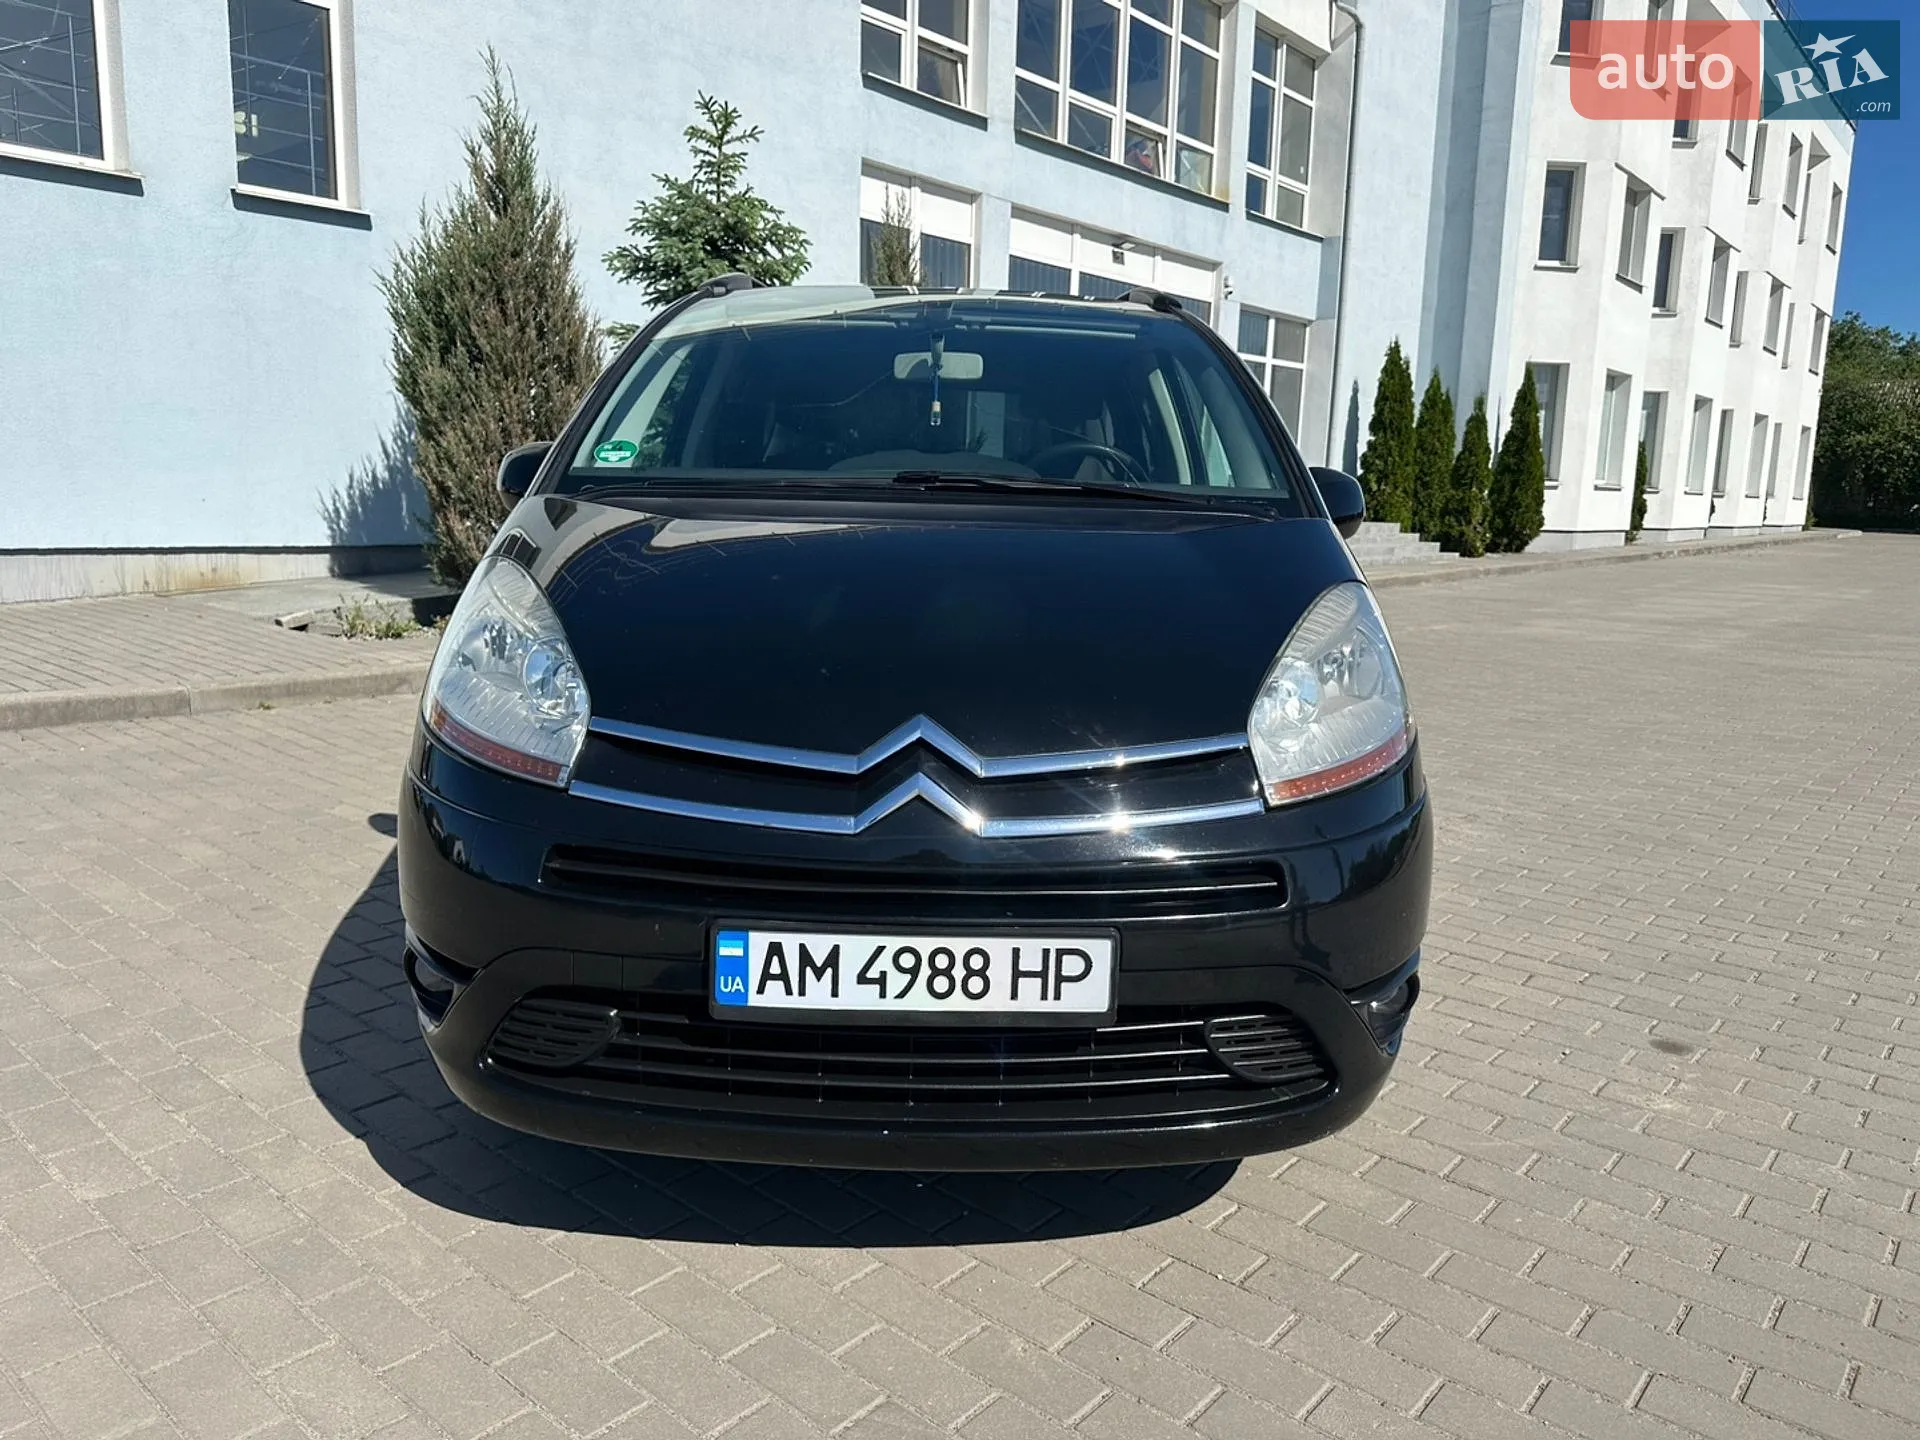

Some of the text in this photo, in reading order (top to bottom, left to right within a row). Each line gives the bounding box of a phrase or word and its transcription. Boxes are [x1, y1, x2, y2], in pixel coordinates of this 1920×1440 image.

[720, 976, 744, 993] UA
[756, 942, 1093, 1001] AM 4988 HP
